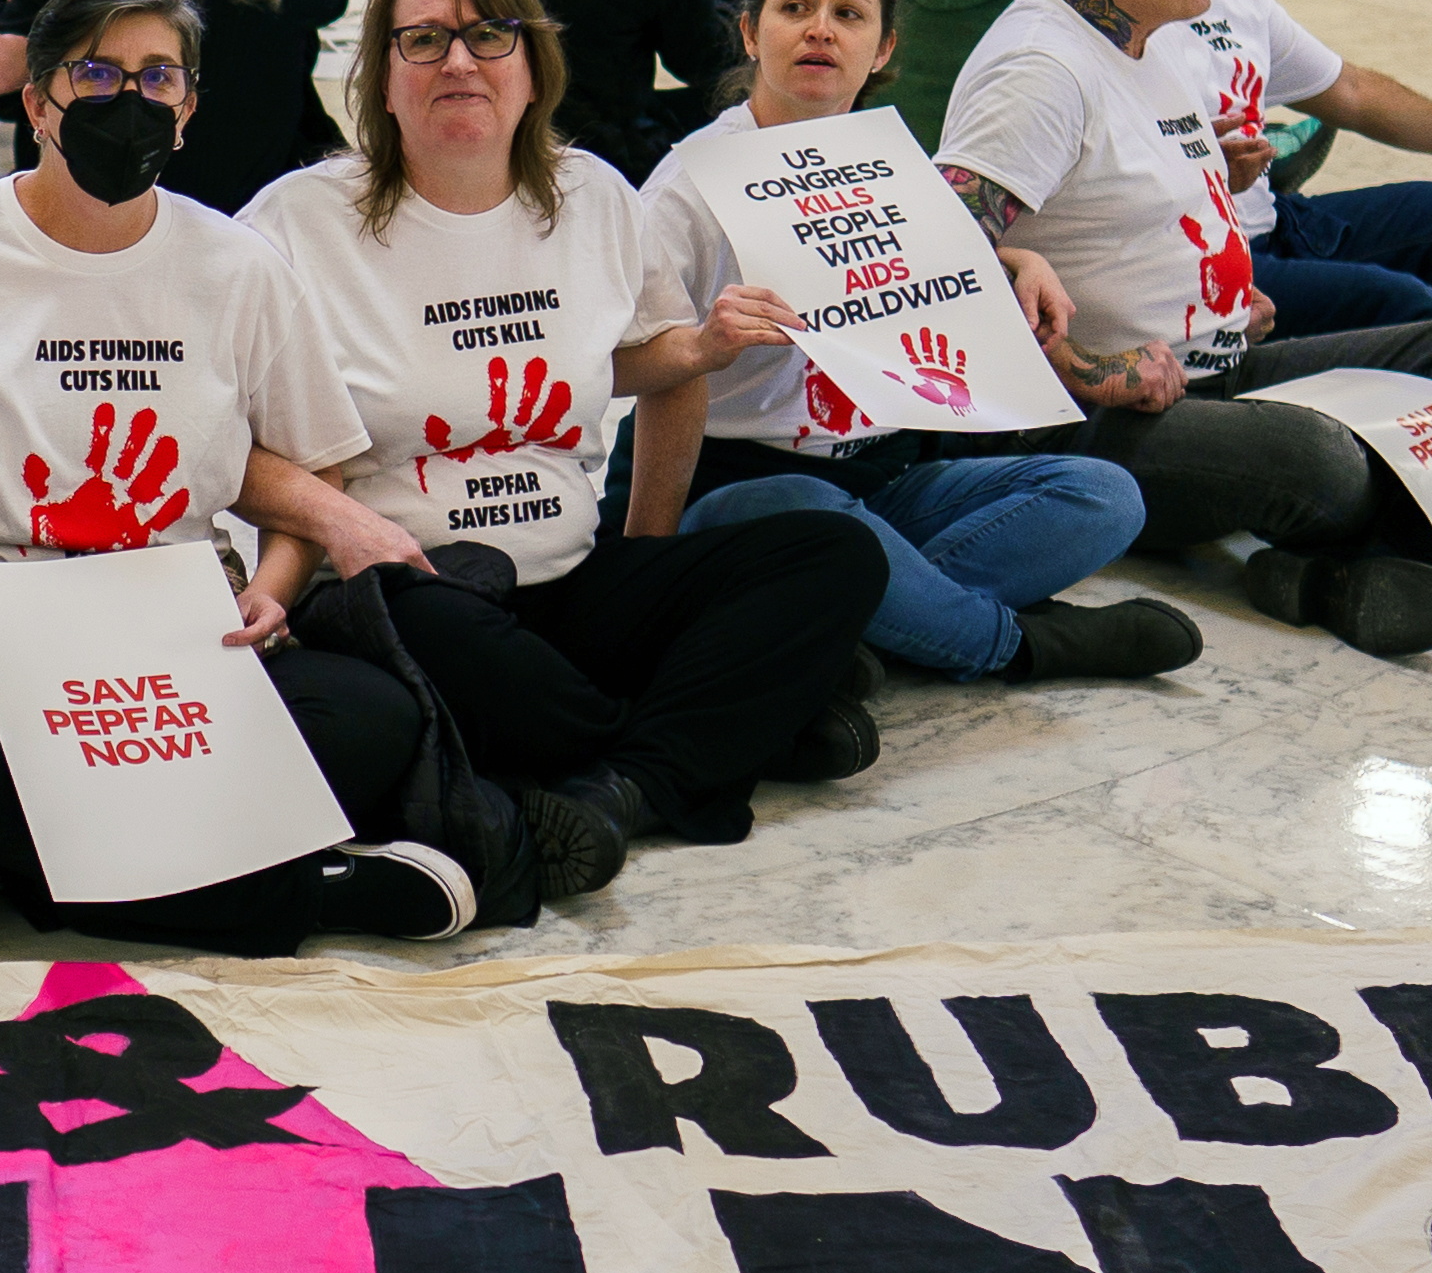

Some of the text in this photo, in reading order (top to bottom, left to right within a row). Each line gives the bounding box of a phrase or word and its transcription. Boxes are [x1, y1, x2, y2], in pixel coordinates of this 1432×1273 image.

[781, 147, 826, 170] US
[744, 159, 895, 201] CONGRESS
[793, 186, 875, 218] KILLS
[792, 204, 908, 245] PEOPLE
[815, 230, 903, 268] WITH
[844, 257, 911, 295] AIDS
[422, 289, 560, 326] AIDS FUNDING
[797, 268, 984, 333] WORLDWIDE
[35, 339, 184, 364] AIDS FUNDING
[451, 319, 546, 351] CUTS KILL
[59, 369, 162, 392] CUTS KILL
[466, 469, 542, 501] PEPFAR
[448, 496, 562, 531] SAVES LIVES
[61, 673, 180, 706] SAVE
[42, 701, 214, 738] PEPFAR
[79, 731, 214, 769] NOW!
